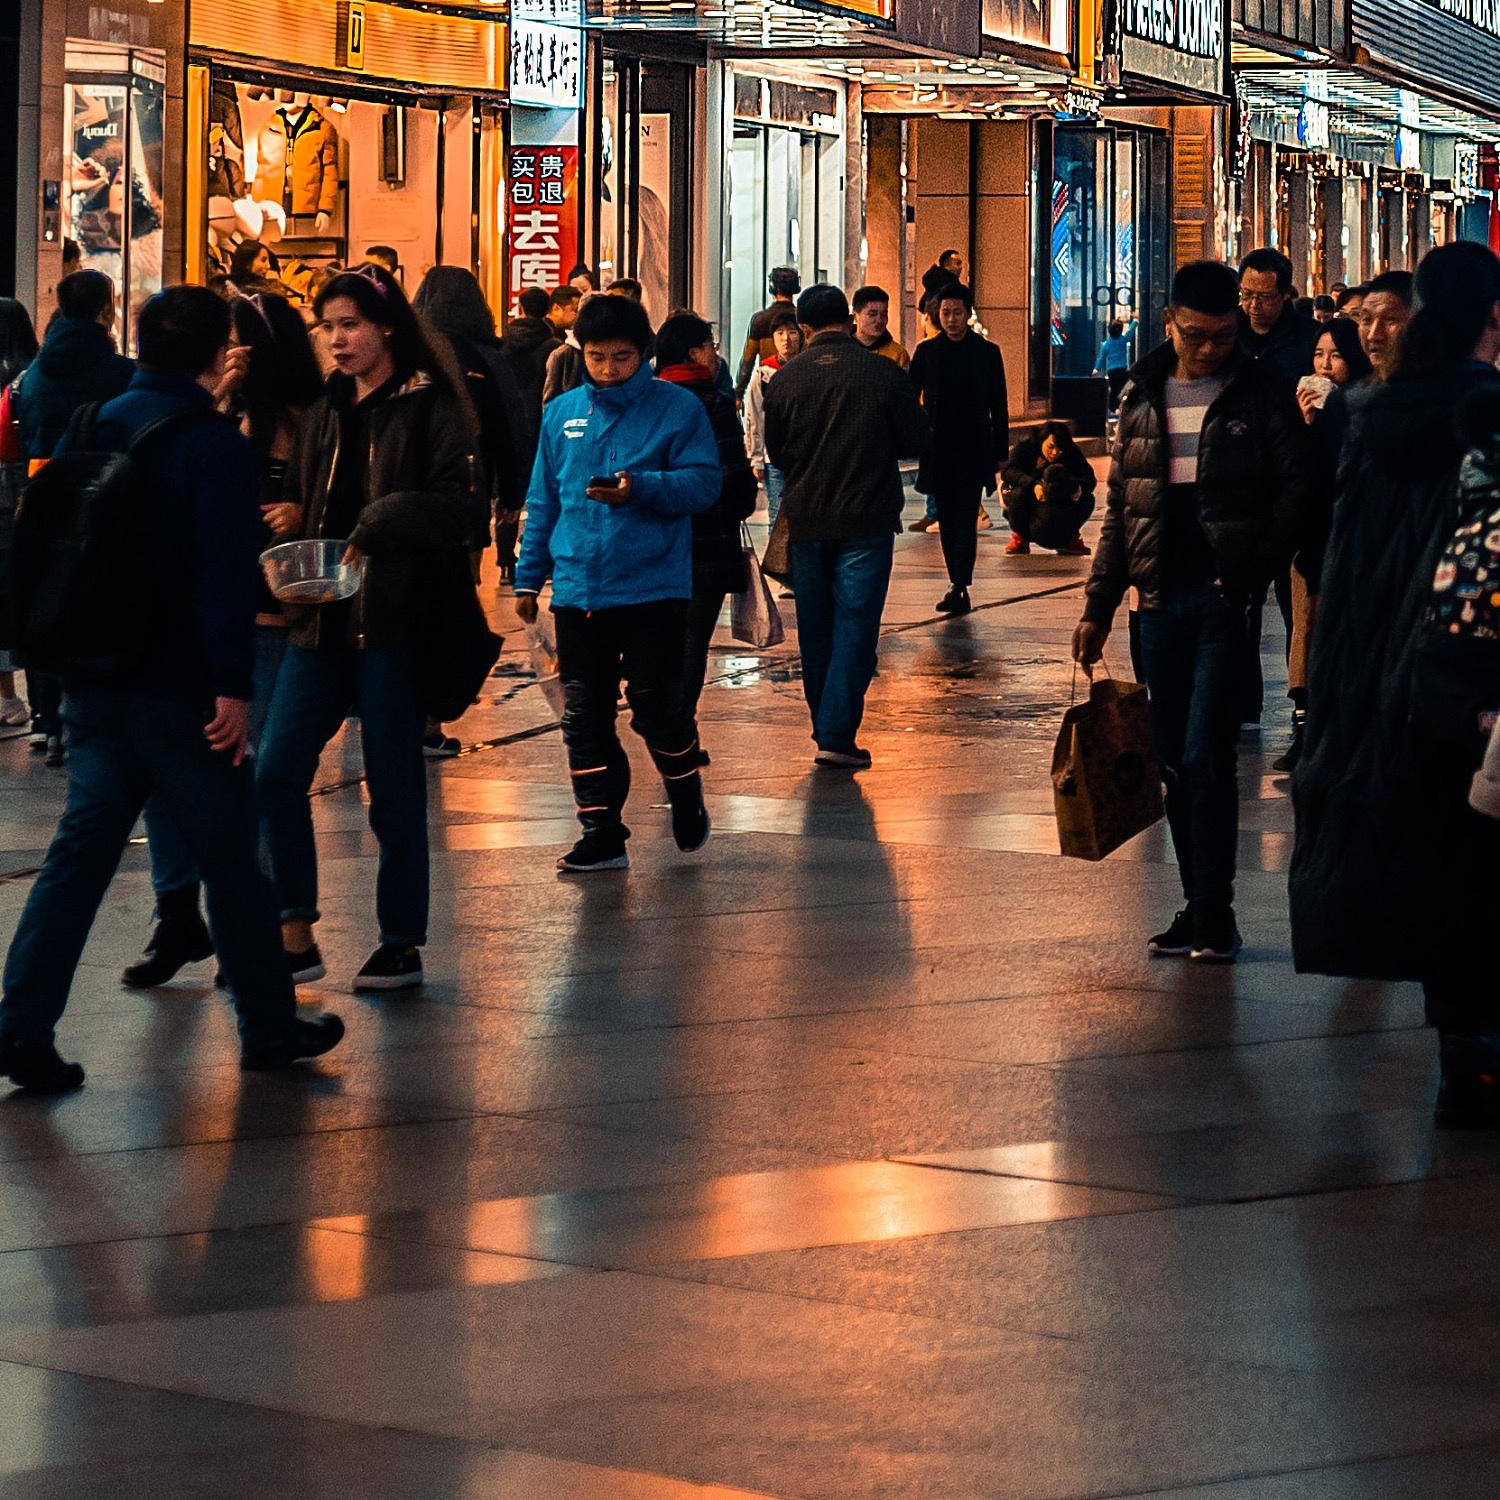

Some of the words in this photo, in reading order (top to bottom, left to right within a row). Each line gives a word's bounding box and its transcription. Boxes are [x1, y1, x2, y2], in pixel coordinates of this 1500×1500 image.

[511, 154, 565, 179] 买贵
[511, 180, 564, 205] 包退
[507, 209, 561, 324] 去库
